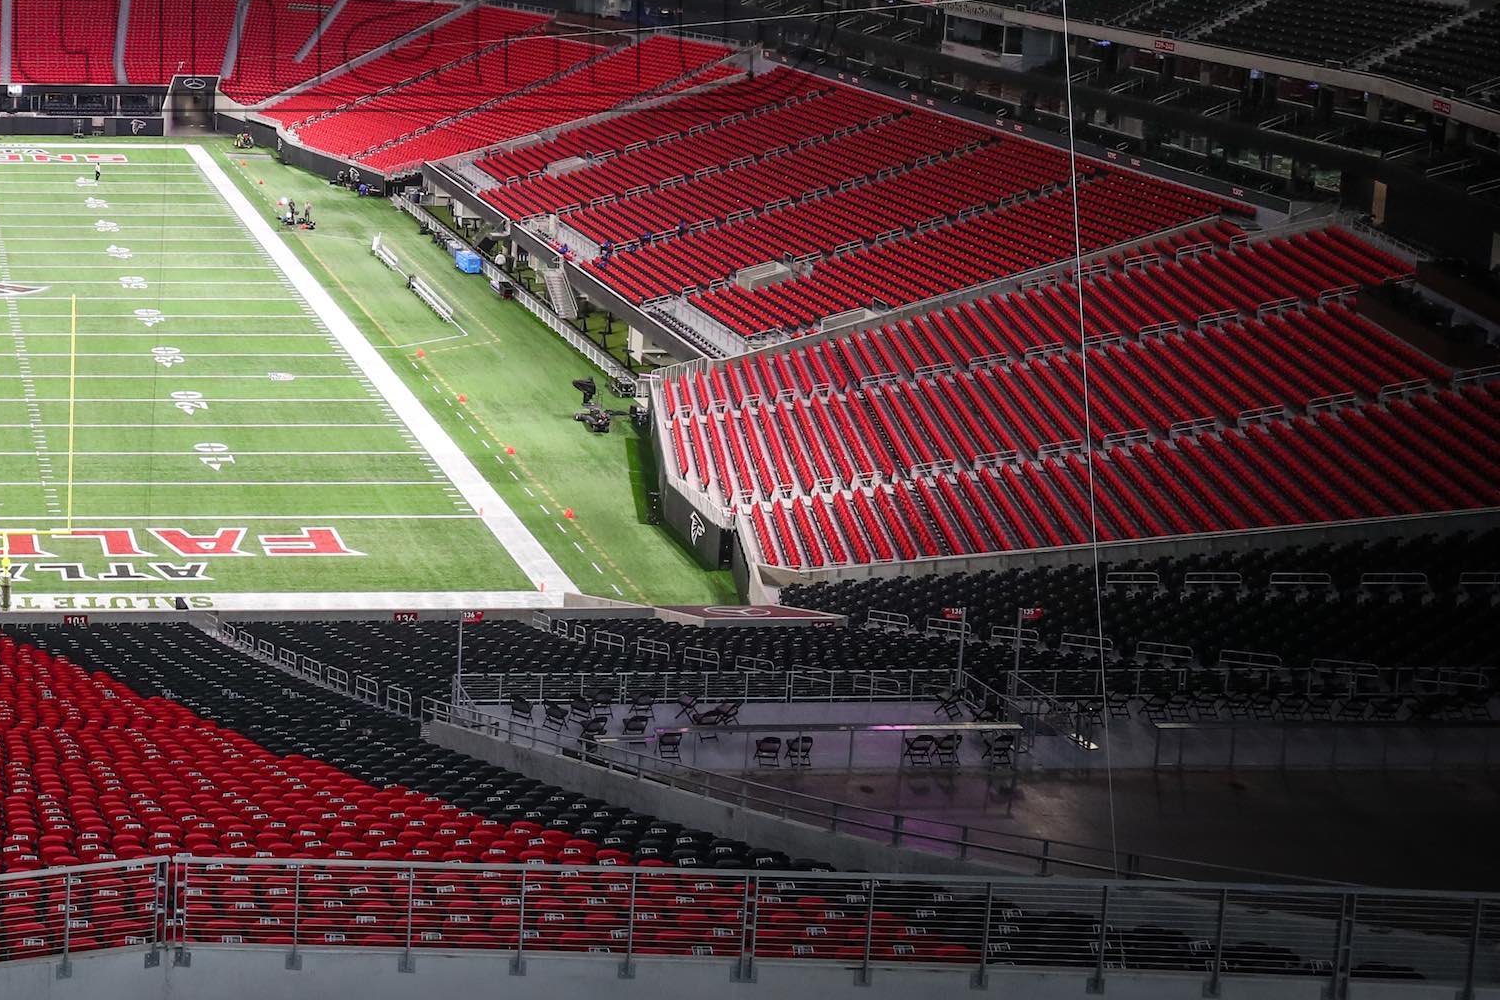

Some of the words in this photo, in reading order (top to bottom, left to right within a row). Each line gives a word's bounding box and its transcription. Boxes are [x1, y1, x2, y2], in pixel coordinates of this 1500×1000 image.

[151, 346, 185, 363] 30
[170, 391, 209, 410] 20
[194, 442, 236, 464] 10
[463, 611, 476, 619] 136
[951, 607, 963, 615] 136
[67, 616, 85, 626] 101
